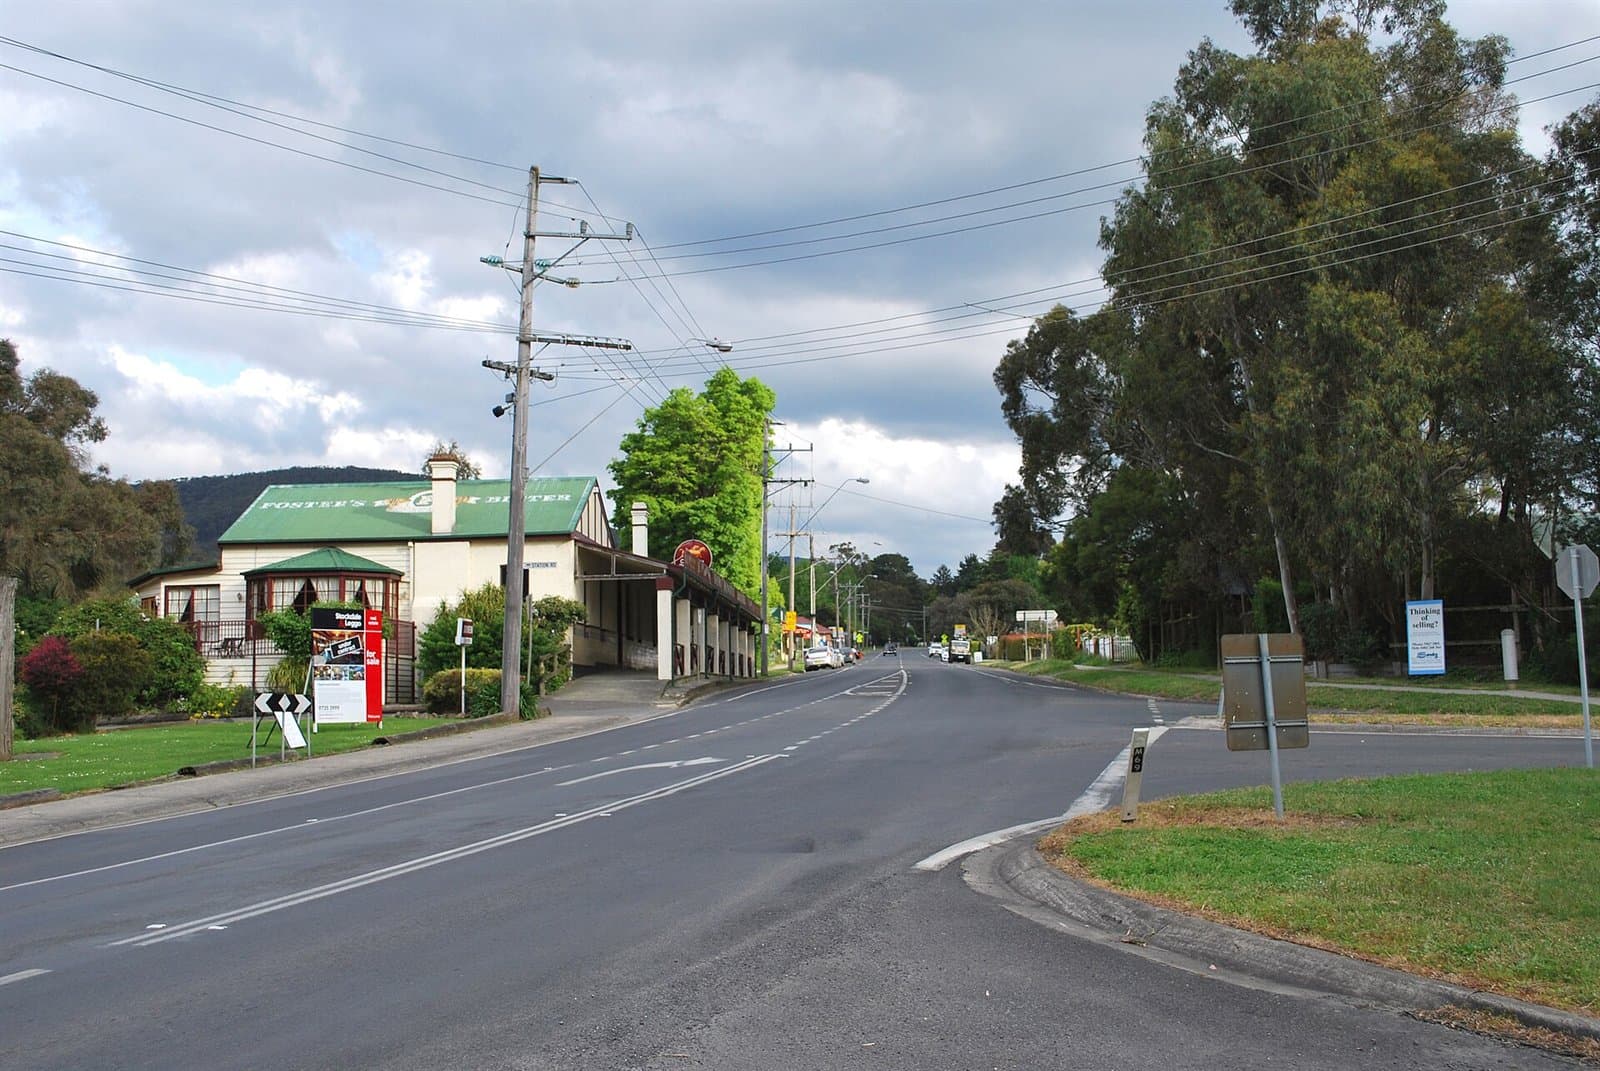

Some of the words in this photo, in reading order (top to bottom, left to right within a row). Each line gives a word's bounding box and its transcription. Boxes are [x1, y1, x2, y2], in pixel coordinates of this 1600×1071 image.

[485, 494, 571, 504] BITER
[1410, 607, 1440, 616] Thinking
[1412, 620, 1439, 630] selling?
